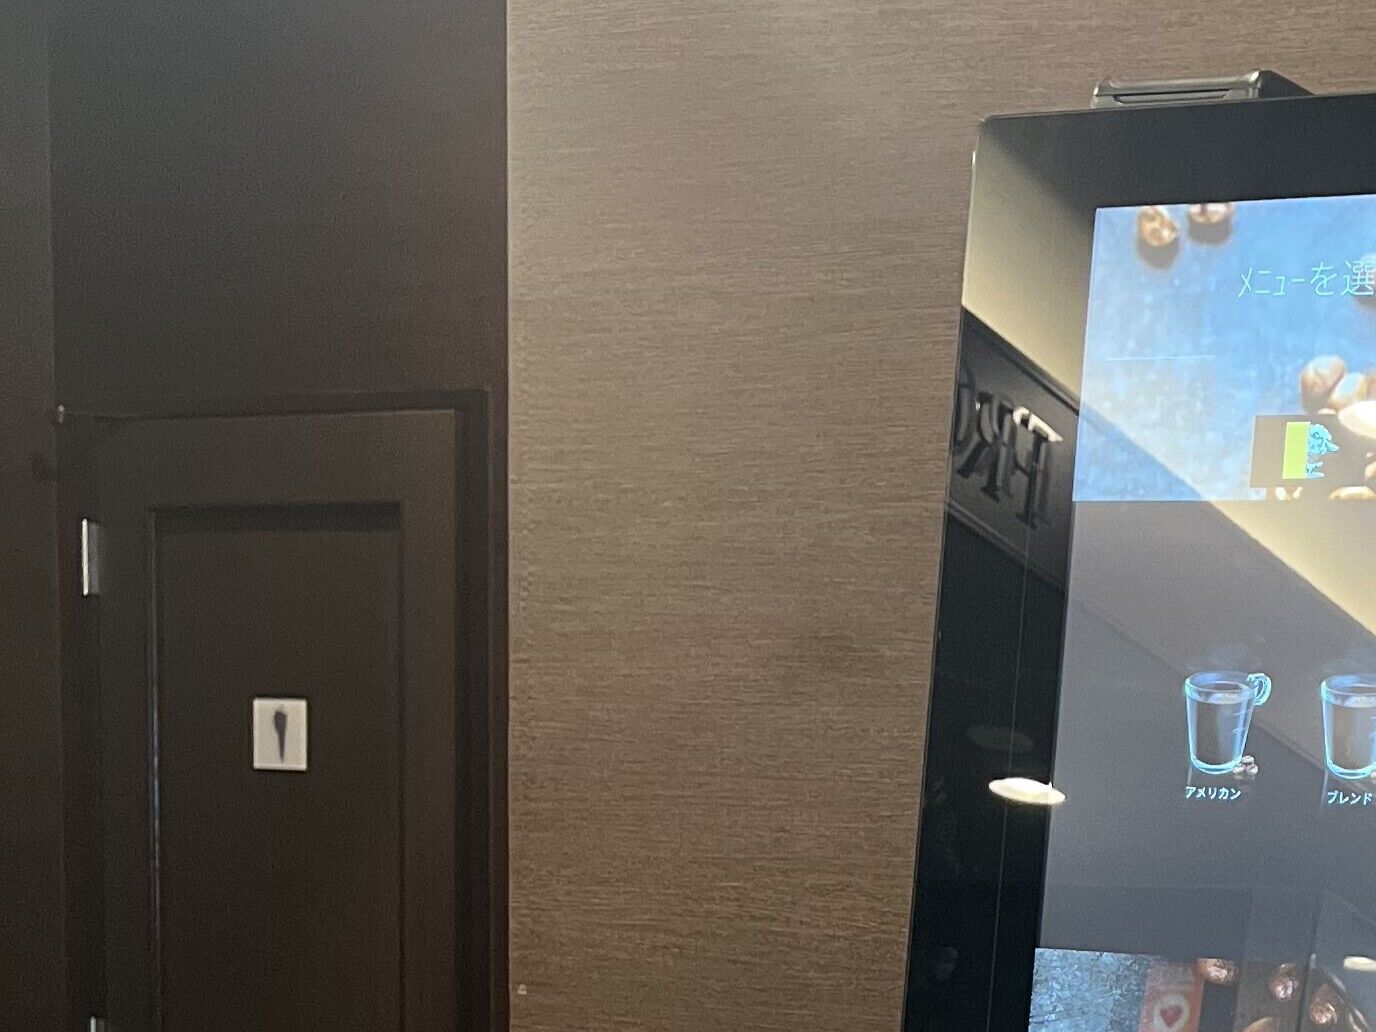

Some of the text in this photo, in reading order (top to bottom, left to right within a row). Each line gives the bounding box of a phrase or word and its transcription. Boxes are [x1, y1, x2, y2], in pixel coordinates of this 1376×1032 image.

[1185, 785, 1242, 801] アメリカン
[1327, 790, 1373, 806] ブレンド
